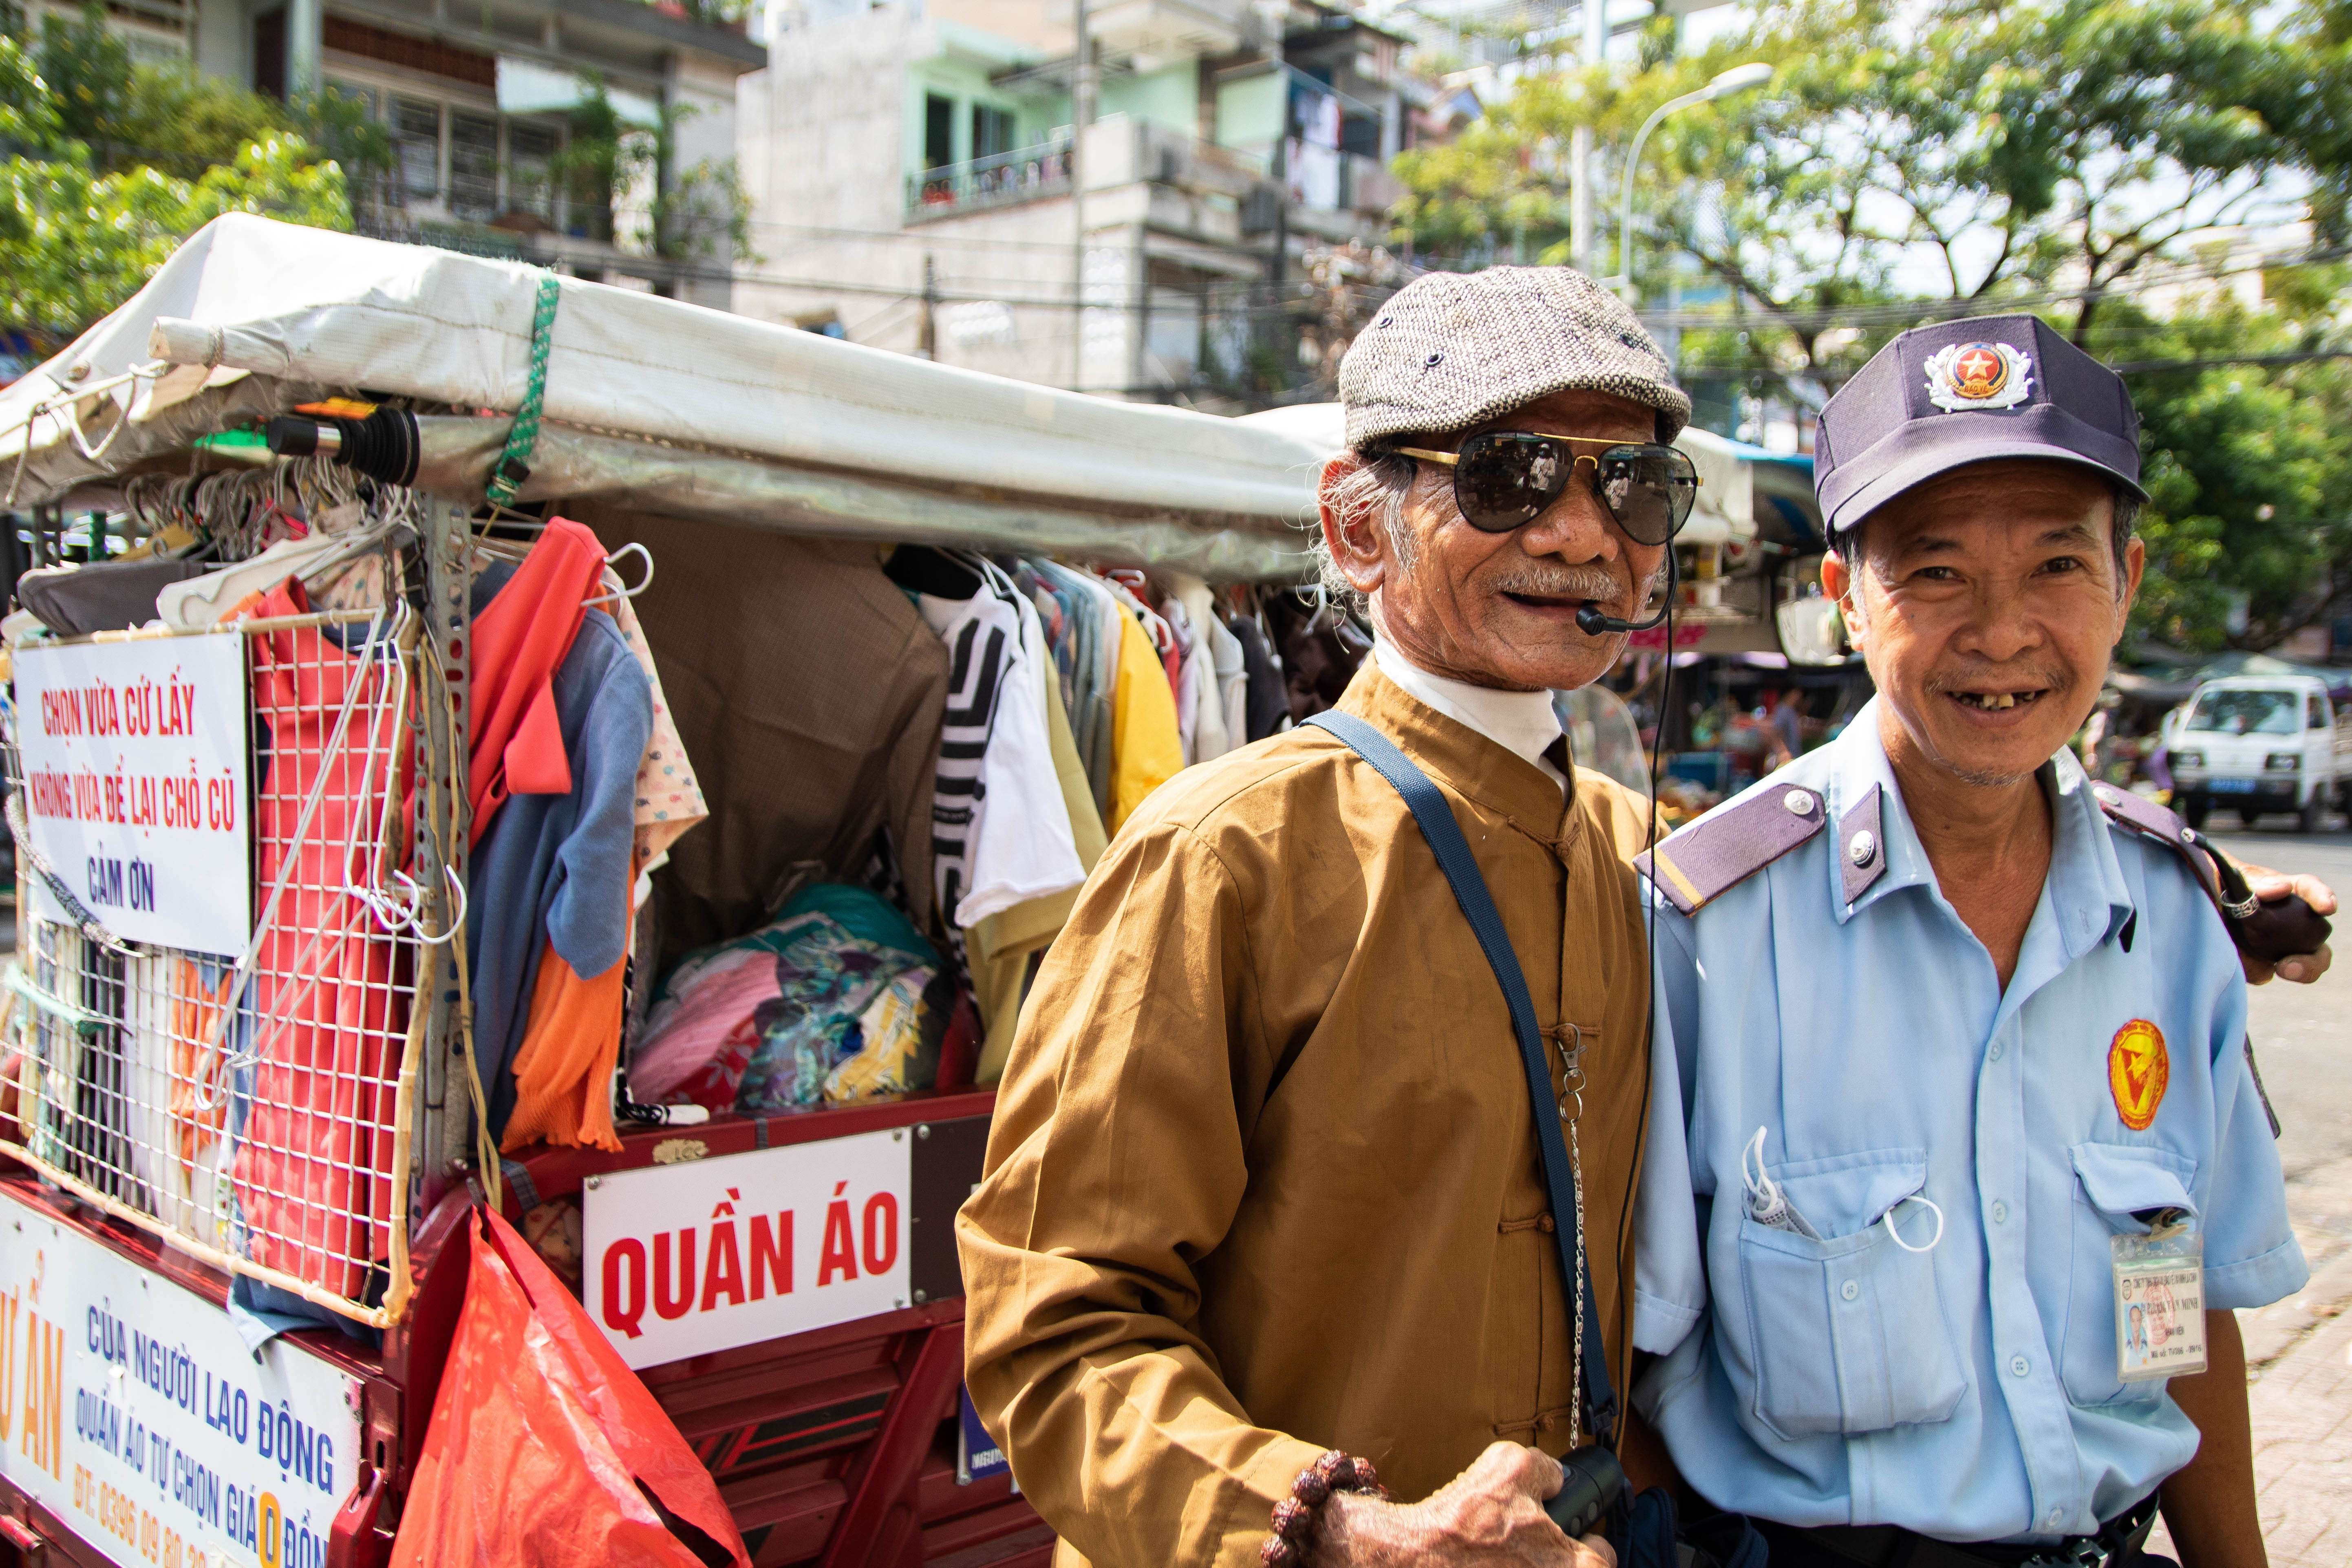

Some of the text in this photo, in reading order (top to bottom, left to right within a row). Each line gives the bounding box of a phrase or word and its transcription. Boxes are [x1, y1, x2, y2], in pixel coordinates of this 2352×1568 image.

[42, 664, 194, 748] CHỌN VỪA CỨ LẤY
[31, 753, 234, 838] KHÔNG VỪA ĐỂ LẠI CHỖ CŨ
[87, 840, 155, 913] CẢM ƠN
[602, 1181, 898, 1339] QUẦN ÁO
[87, 1295, 334, 1496] CỦA NGƯỜI LAO ĐỘNG
[75, 1462, 95, 1519] ĐT:
[99, 1481, 137, 1547] 0396
[141, 1510, 160, 1564] 09
[124, 1405, 146, 1473] ÁO
[150, 1430, 171, 1503] TỰ
[174, 1449, 221, 1530] CHỌN
[227, 1484, 257, 1554] GIÁ
[282, 1508, 329, 1568] ĐỒN
